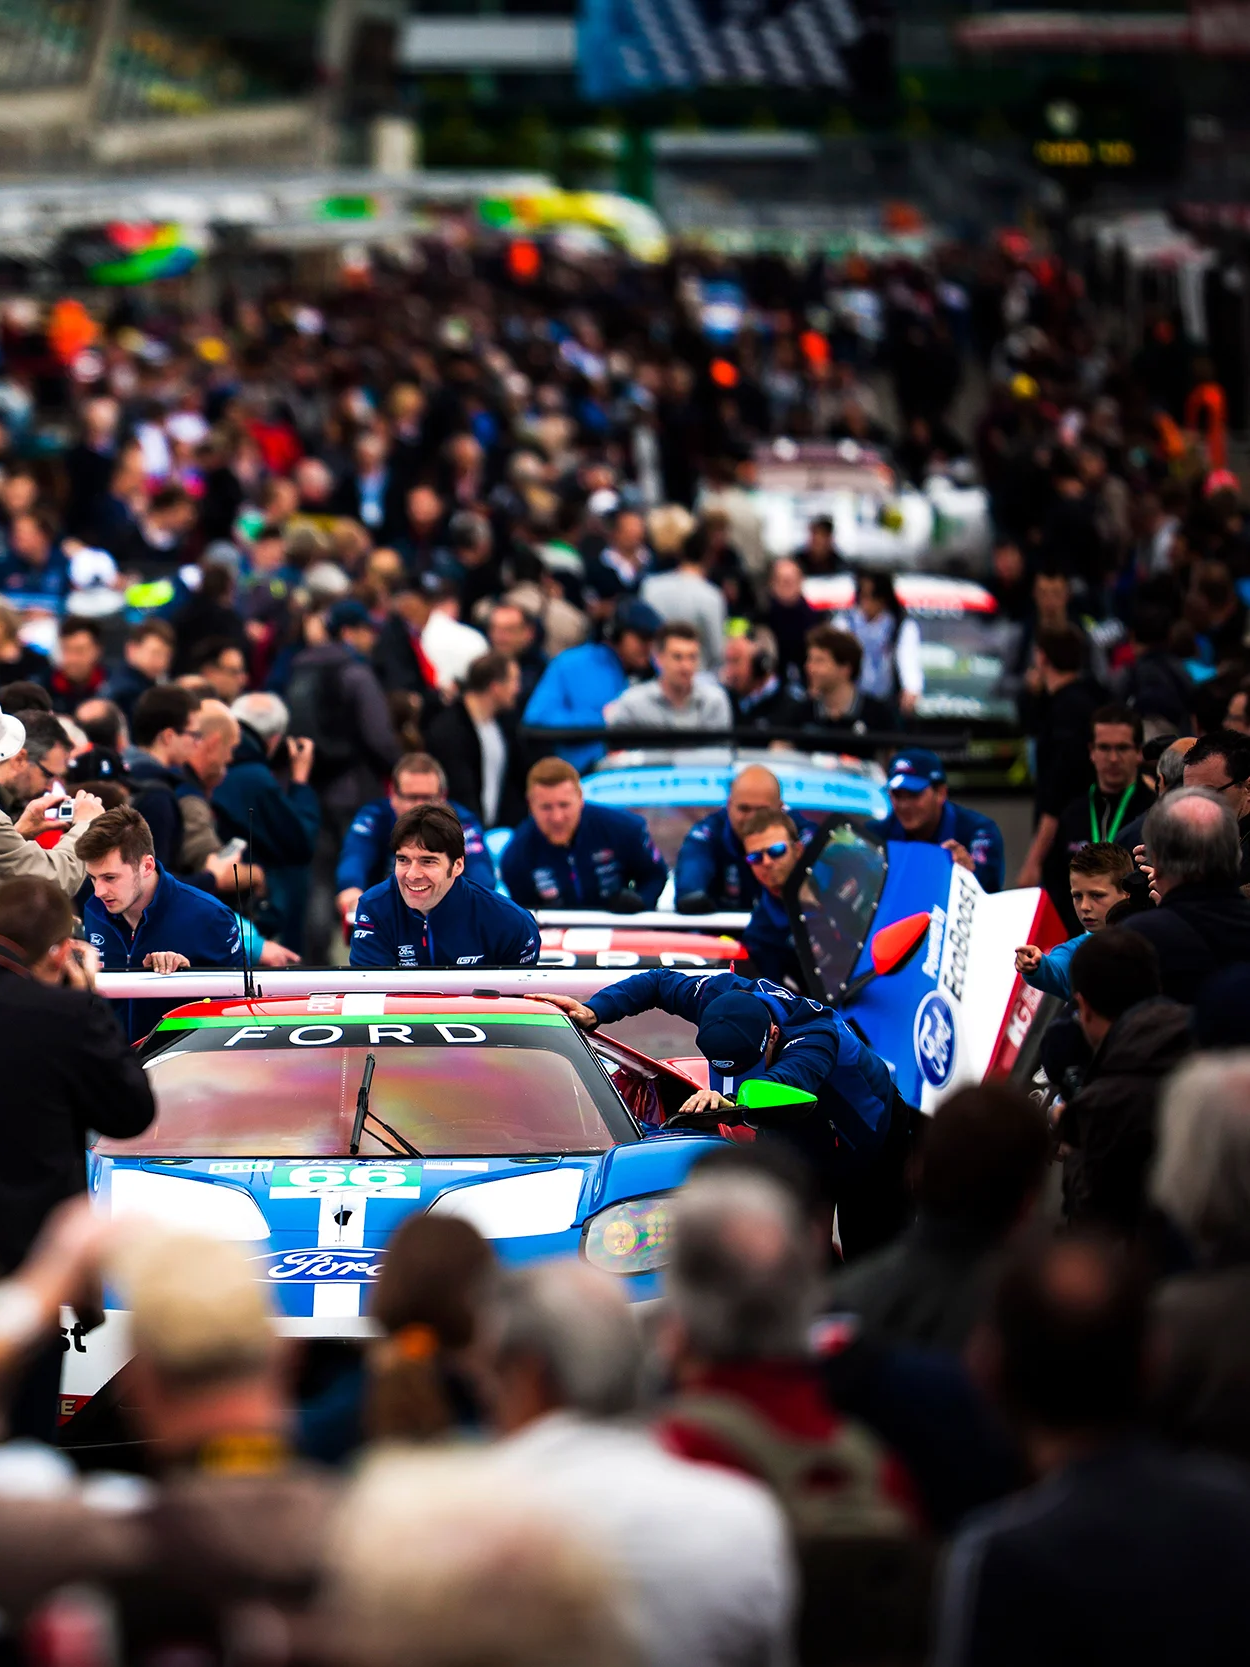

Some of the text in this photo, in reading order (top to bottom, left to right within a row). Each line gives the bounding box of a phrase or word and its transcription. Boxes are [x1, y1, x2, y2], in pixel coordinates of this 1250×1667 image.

[223, 1022, 488, 1047] FORD
[918, 1005, 953, 1078] Ford
[288, 1165, 407, 1187] 66
